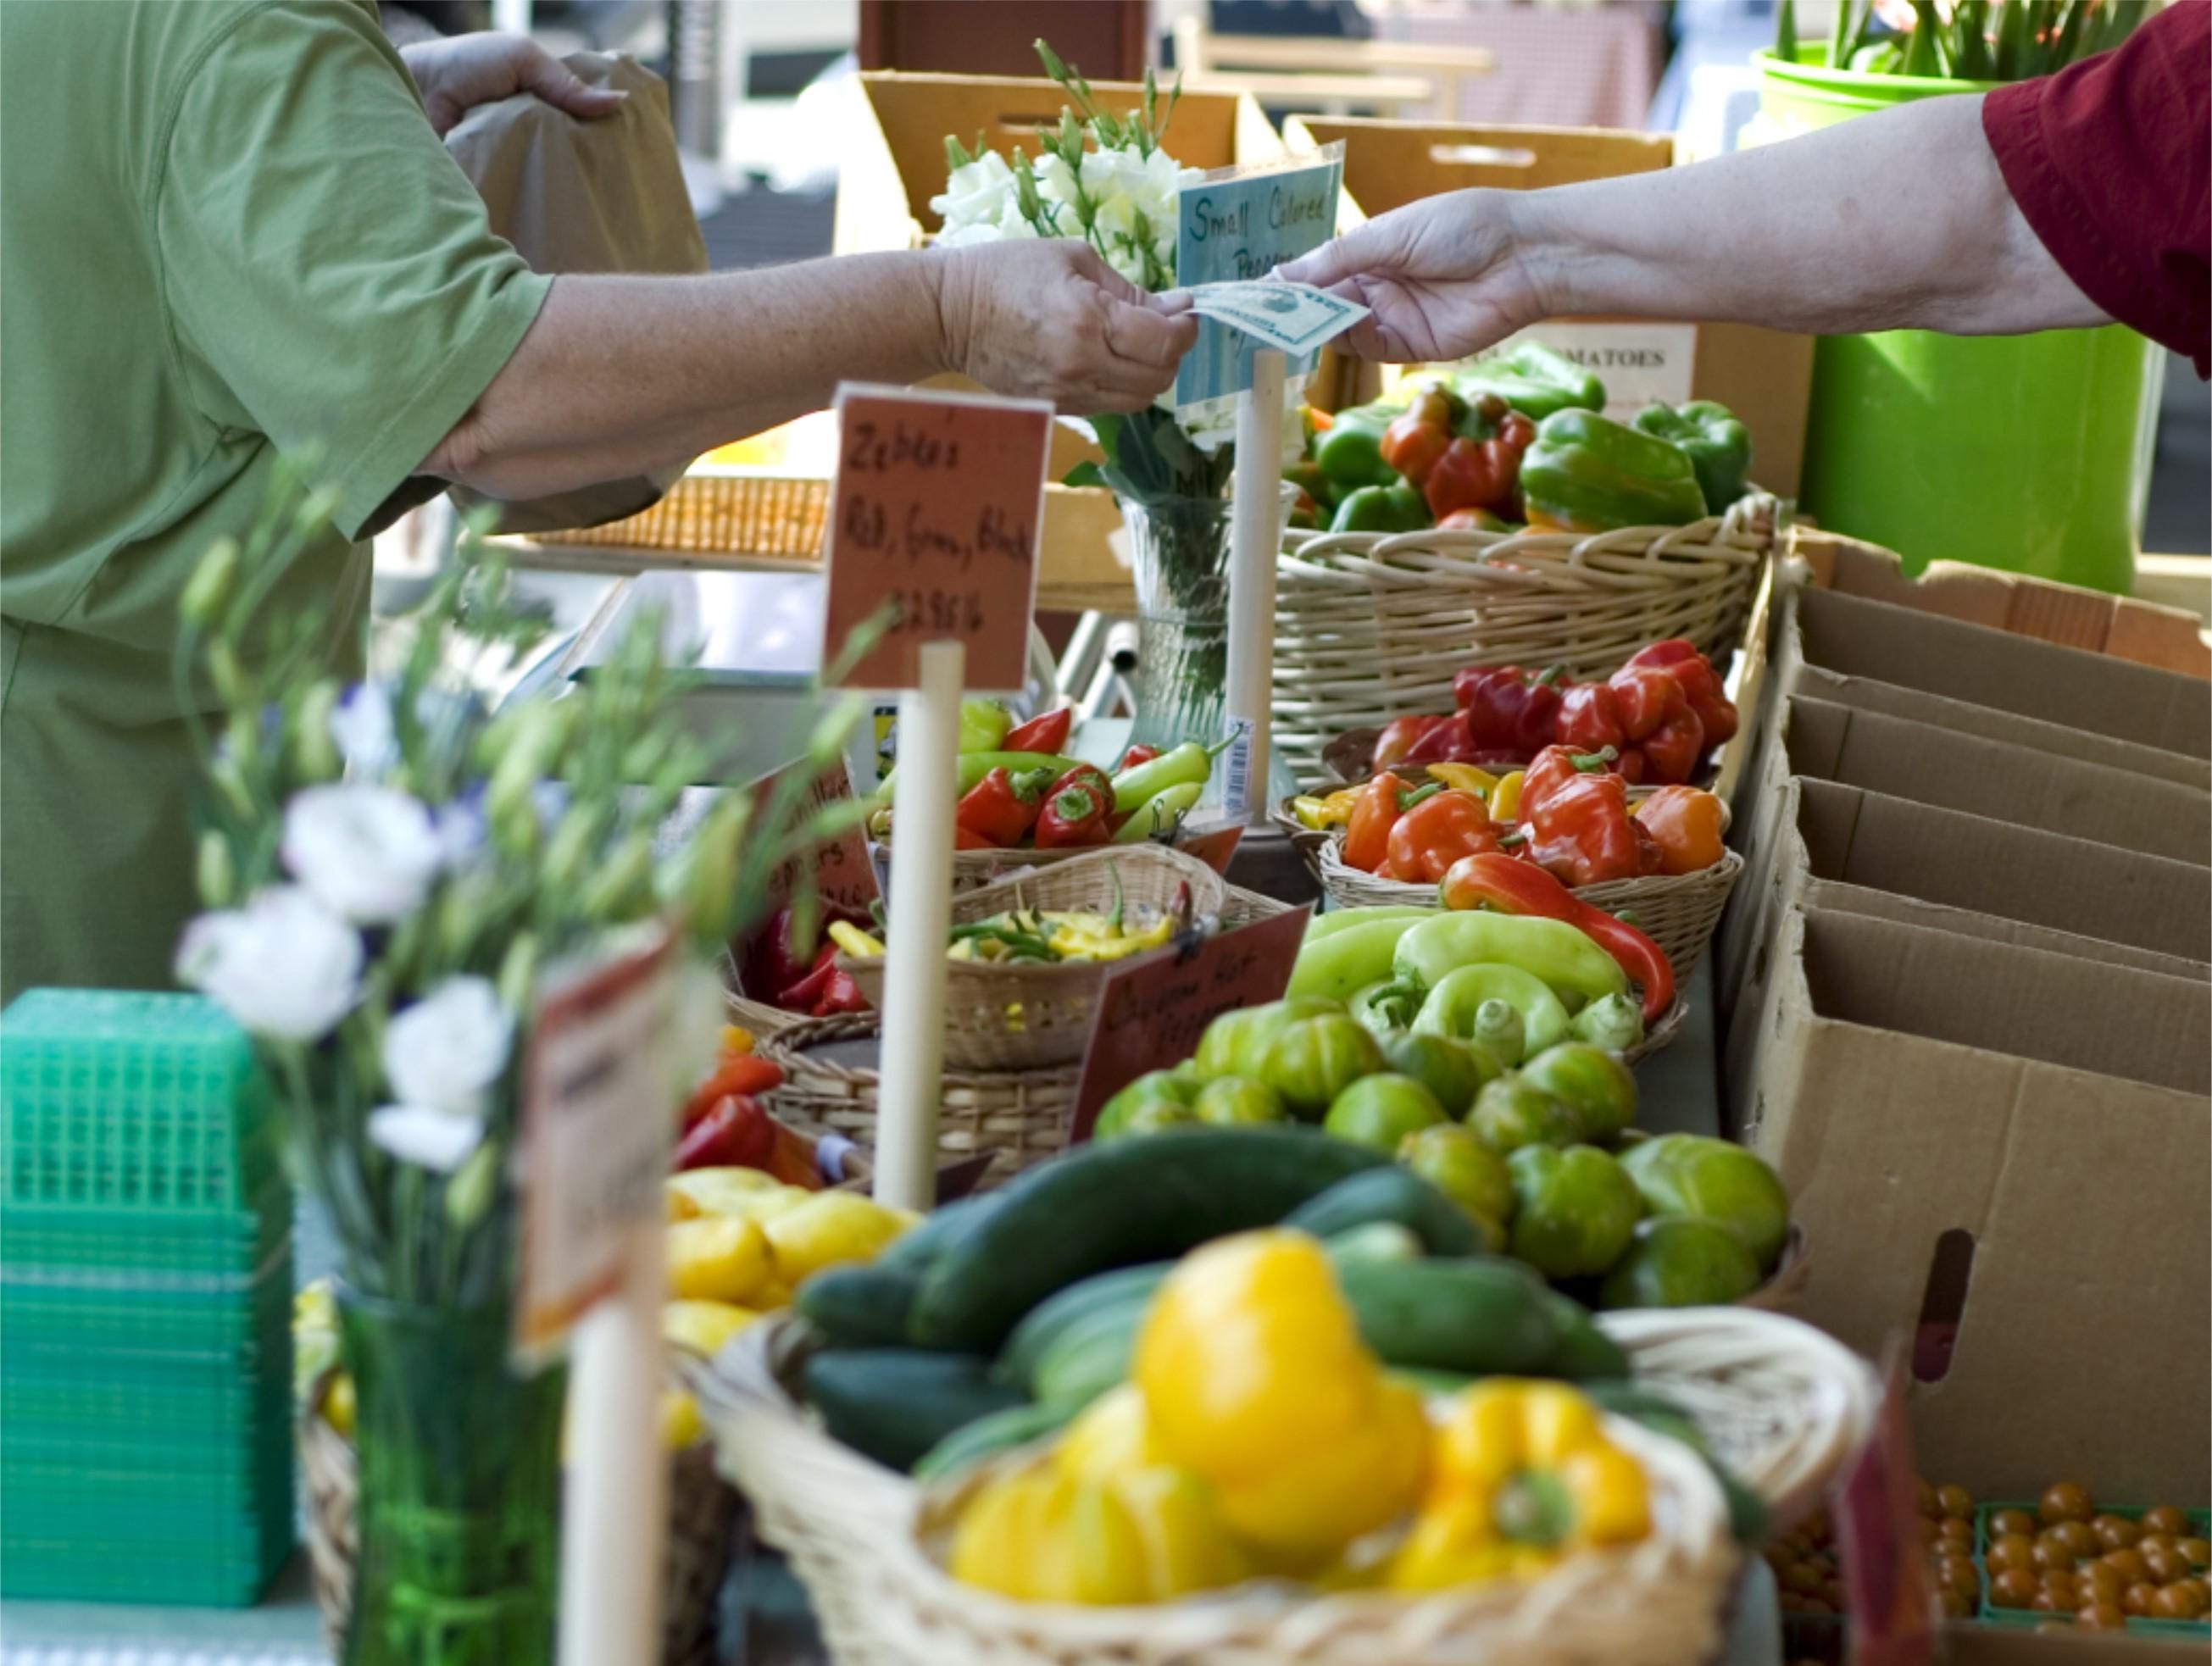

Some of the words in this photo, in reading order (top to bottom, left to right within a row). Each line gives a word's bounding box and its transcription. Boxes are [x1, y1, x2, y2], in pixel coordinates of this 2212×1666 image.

[1189, 196, 1249, 242] Small
[1268, 185, 1326, 230] Colored
[1232, 247, 1294, 280] Pepp
[1558, 347, 1665, 368] MATOES
